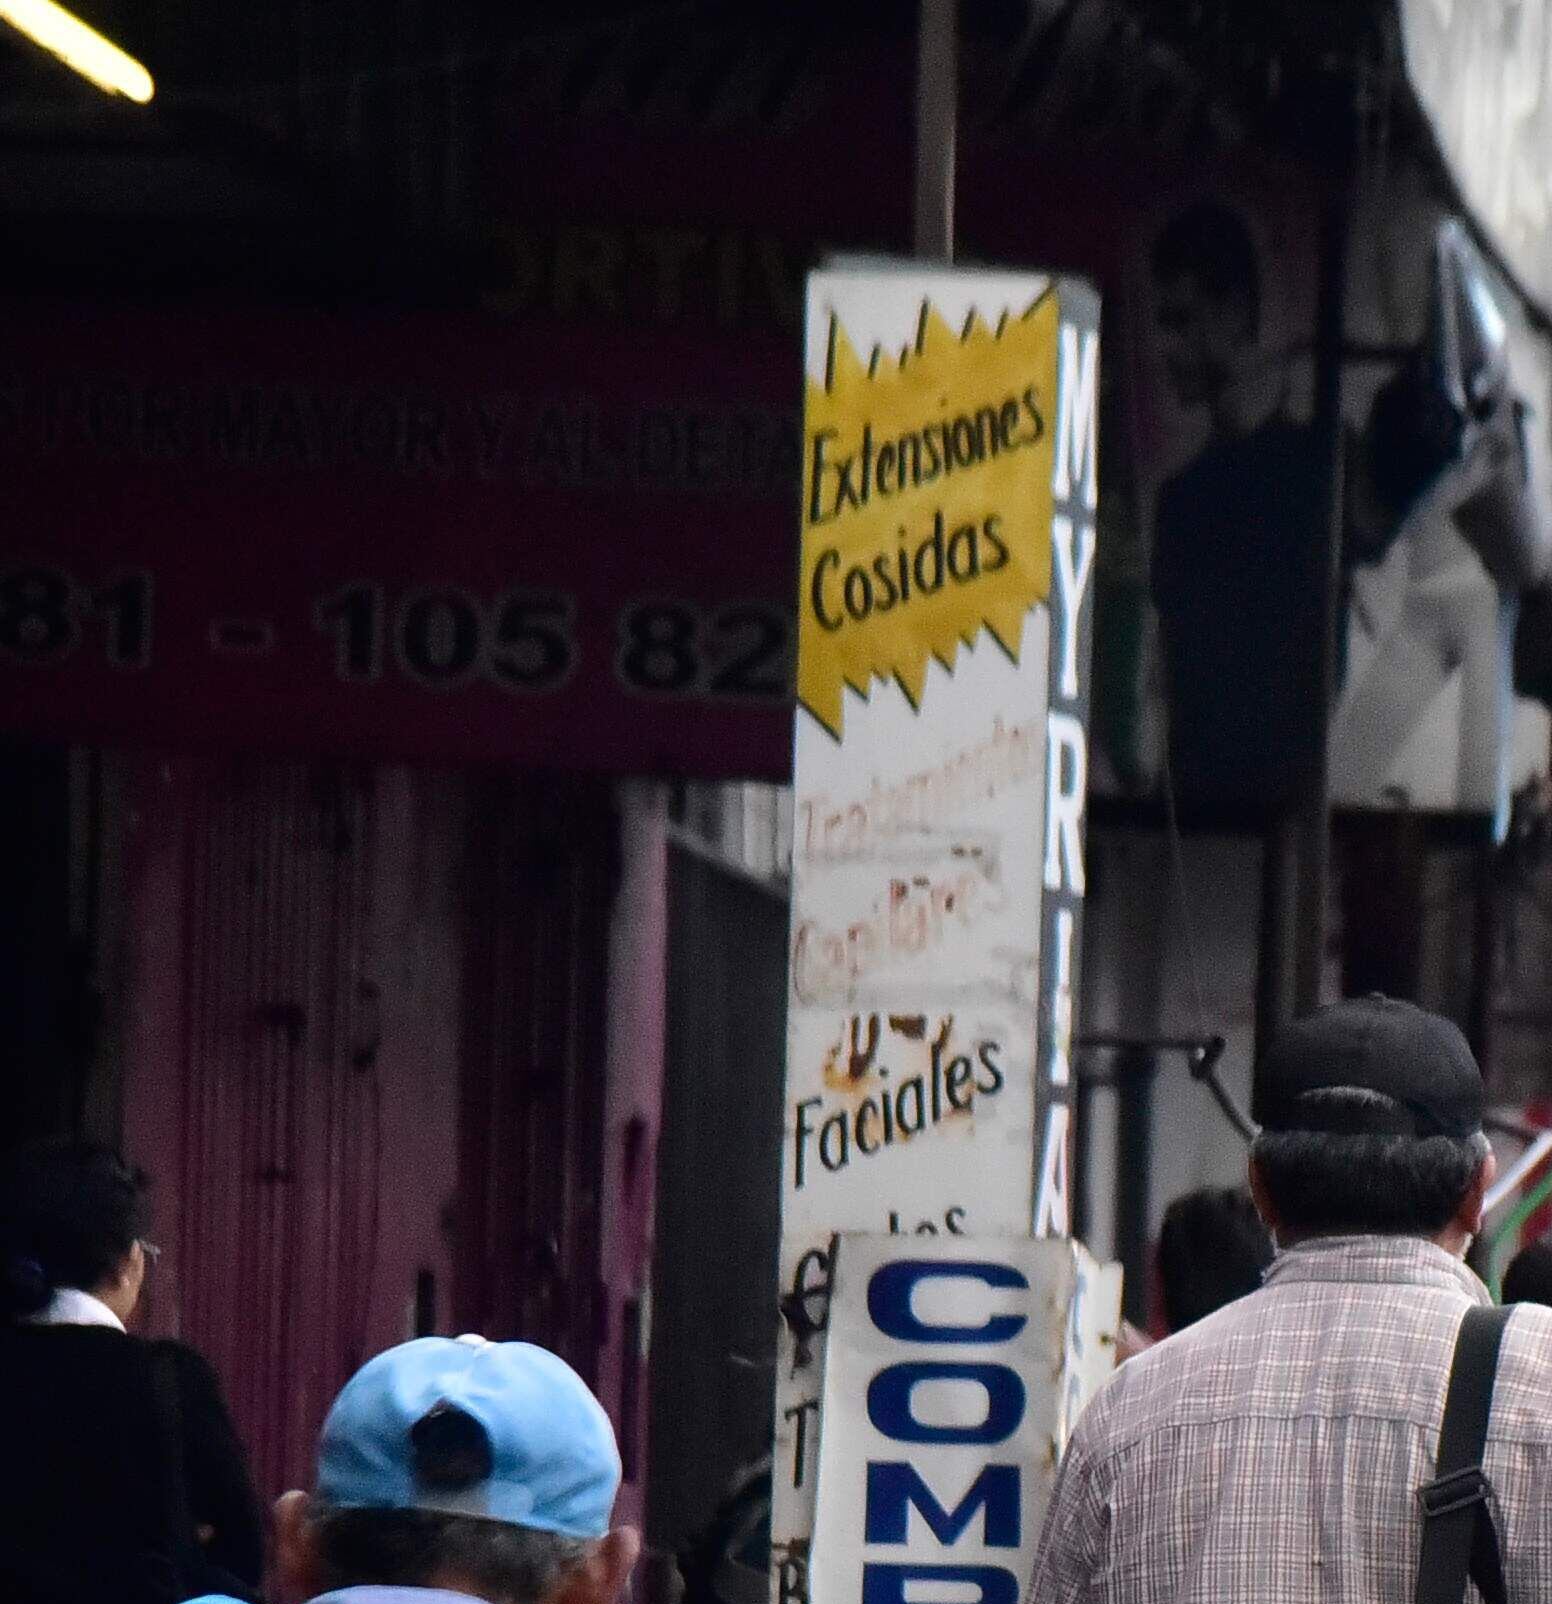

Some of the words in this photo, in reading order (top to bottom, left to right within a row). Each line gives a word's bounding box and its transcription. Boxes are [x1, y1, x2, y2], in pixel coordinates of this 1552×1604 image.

[808, 383, 1047, 526] Extensiones
[312, 580, 578, 692] 105
[810, 508, 1011, 632] Cosidas
[795, 1039, 1005, 1190] Faciales
